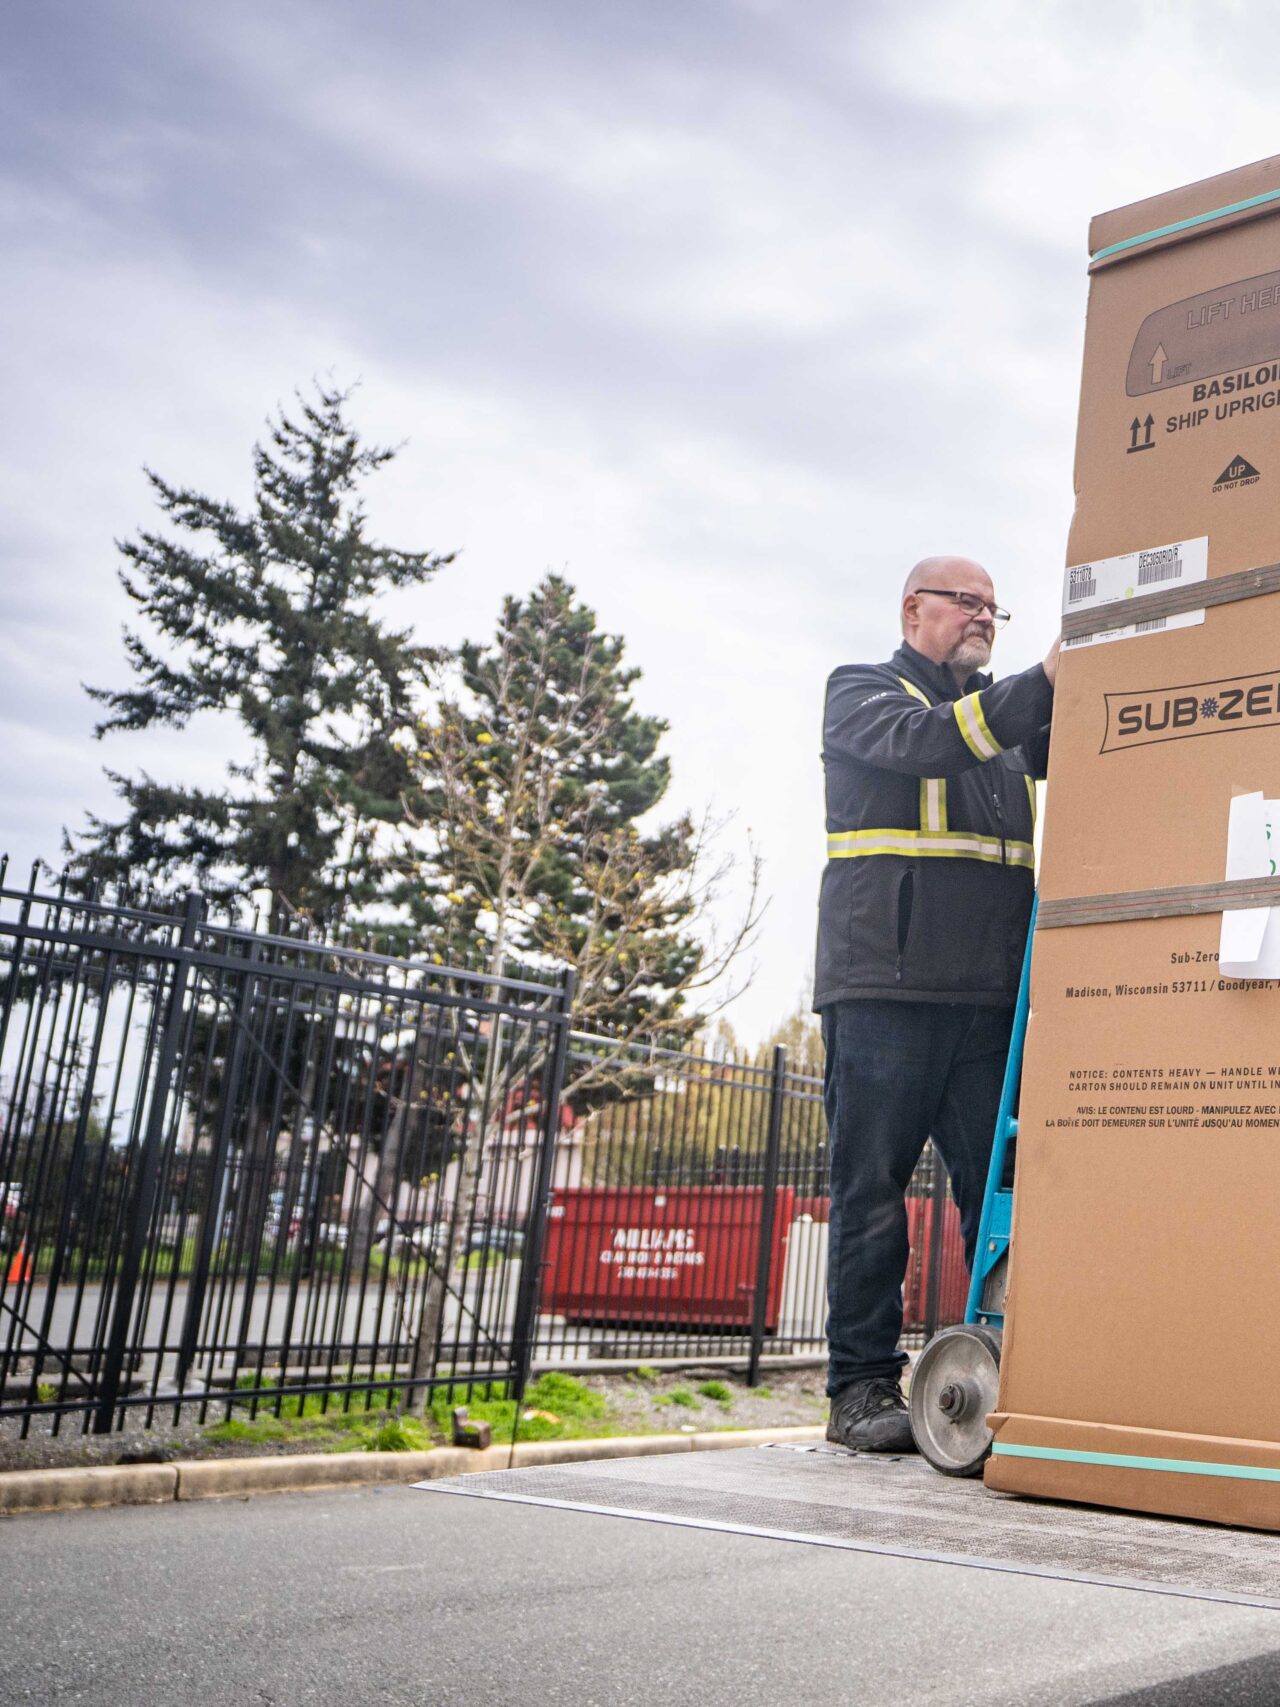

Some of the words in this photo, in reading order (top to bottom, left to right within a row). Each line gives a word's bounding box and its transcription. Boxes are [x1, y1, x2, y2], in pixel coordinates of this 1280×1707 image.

[1187, 298, 1235, 330] LIFT
[1166, 408, 1209, 433] SHIP
[1229, 464, 1245, 478] UP
[1212, 485, 1222, 493] DO
[1224, 481, 1238, 491] NOT
[1240, 476, 1260, 487] DROP
[1170, 951, 1219, 965] Sub-Zero
[1065, 987, 1112, 998] Madison,
[1115, 983, 1168, 996] Wisconsin
[1172, 980, 1206, 993] 53711
[1210, 980, 1215, 991] /
[1218, 979, 1273, 991] Goodyear,
[1069, 1070, 1108, 1079] NOTICE:
[1112, 1069, 1164, 1078] CONTENTS
[1168, 1068, 1201, 1077] HEAVY
[1221, 1067, 1263, 1076] HANDLE
[1068, 1082, 1107, 1091] CARTON
[1109, 1082, 1148, 1091] SHOULD
[1150, 1081, 1190, 1090] REMAIN
[1193, 1081, 1206, 1090] ON
[1209, 1080, 1234, 1090] UNIT
[1236, 1080, 1267, 1089] UNTIL
[1076, 1106, 1096, 1115] AVIS:
[1098, 1106, 1108, 1115] LE
[1110, 1106, 1147, 1115] CONTENU
[1149, 1106, 1164, 1115] EST
[1166, 1106, 1194, 1115] LOURD
[1201, 1105, 1251, 1115] MANIPULEZ
[1254, 1105, 1276, 1114] AVEC
[1045, 1119, 1055, 1127] LA
[1081, 1119, 1100, 1127] DOIT
[1102, 1119, 1146, 1127] DEMEURER
[1148, 1119, 1165, 1127] SUR
[1168, 1117, 1199, 1127] L'UNITÉ
[1201, 1118, 1243, 1128] JUSQU'AU
